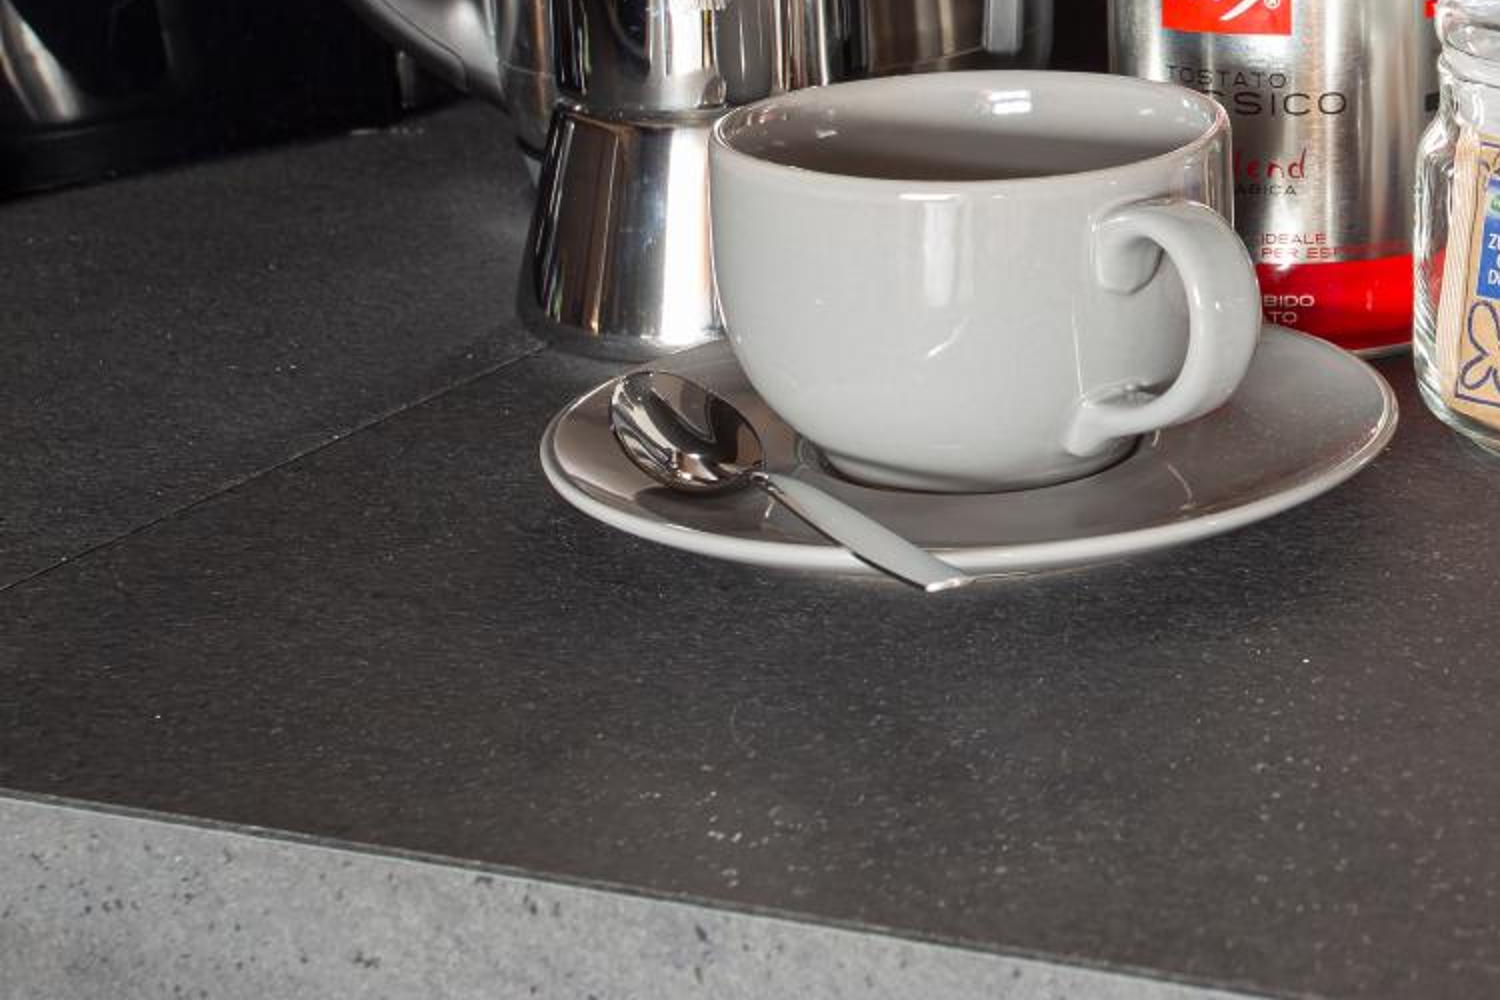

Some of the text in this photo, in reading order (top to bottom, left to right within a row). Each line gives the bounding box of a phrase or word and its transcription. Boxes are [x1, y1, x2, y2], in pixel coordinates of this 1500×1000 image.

[1168, 65, 1287, 89] TOSTATO
[1234, 147, 1307, 180] lend
[1235, 183, 1297, 196] ABICA
[1261, 233, 1326, 245] IDEALE
[1262, 294, 1315, 308] BIDO
[1263, 311, 1298, 324] TO
